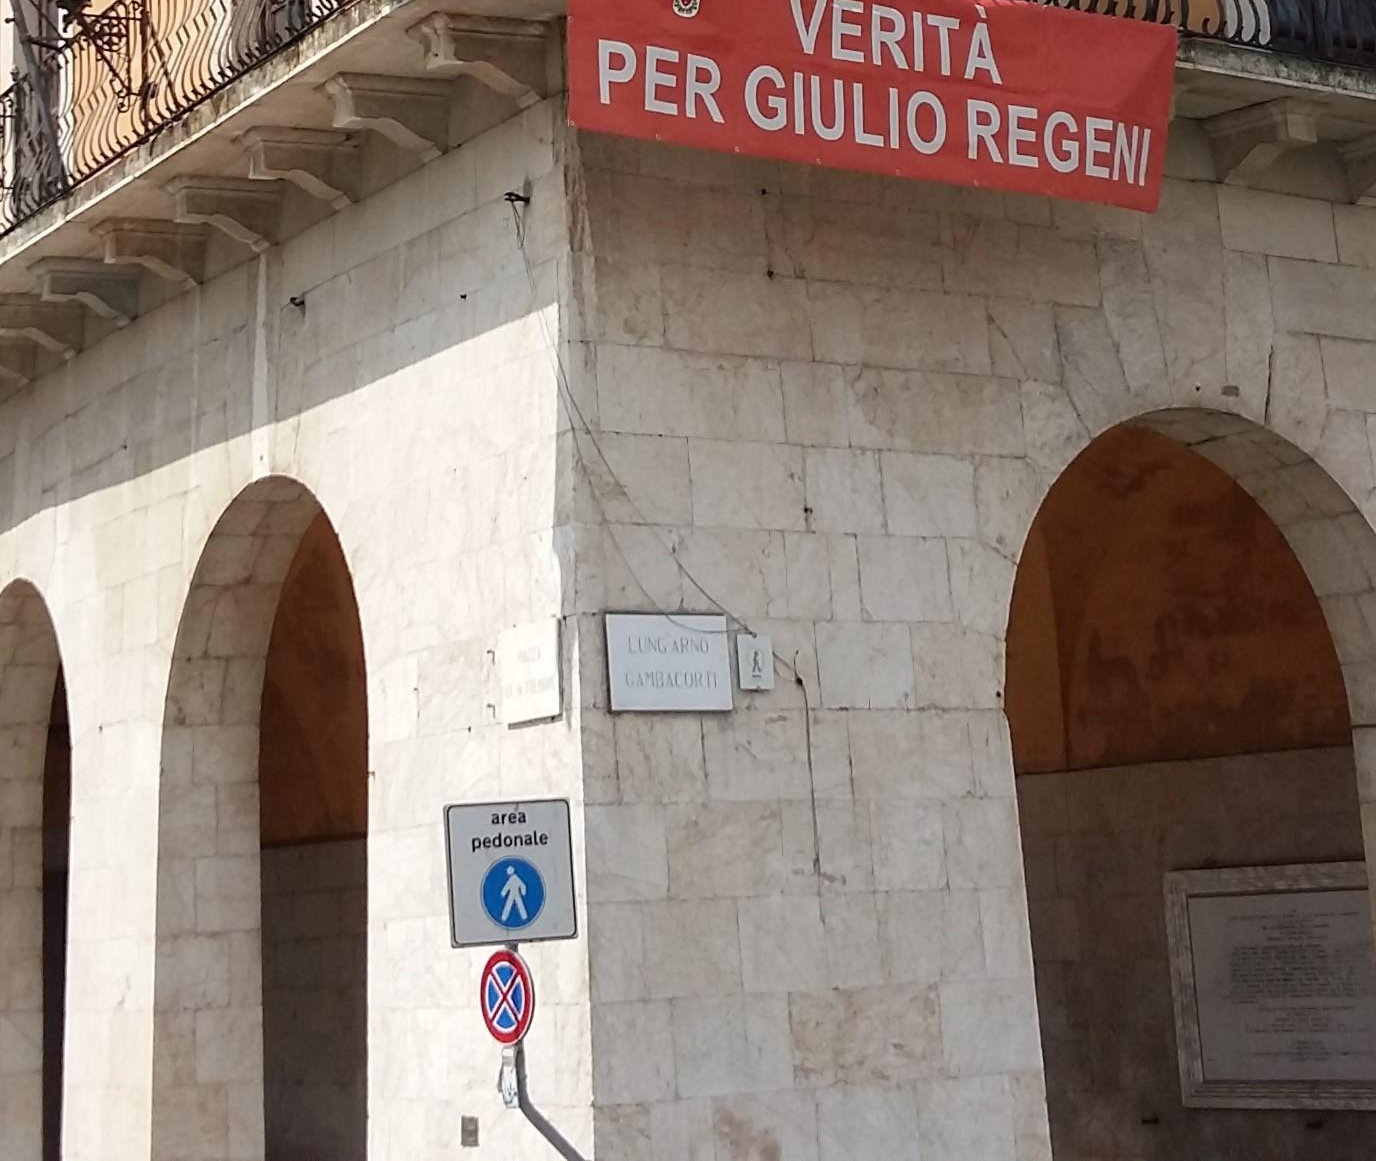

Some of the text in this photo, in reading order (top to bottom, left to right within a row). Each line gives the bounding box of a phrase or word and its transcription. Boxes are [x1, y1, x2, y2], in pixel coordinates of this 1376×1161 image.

[598, 38, 1152, 187] PER GIULIO REGENI
[625, 671, 718, 688] GAMBACORTI
[491, 811, 526, 825] area
[471, 830, 548, 853] pedonale
